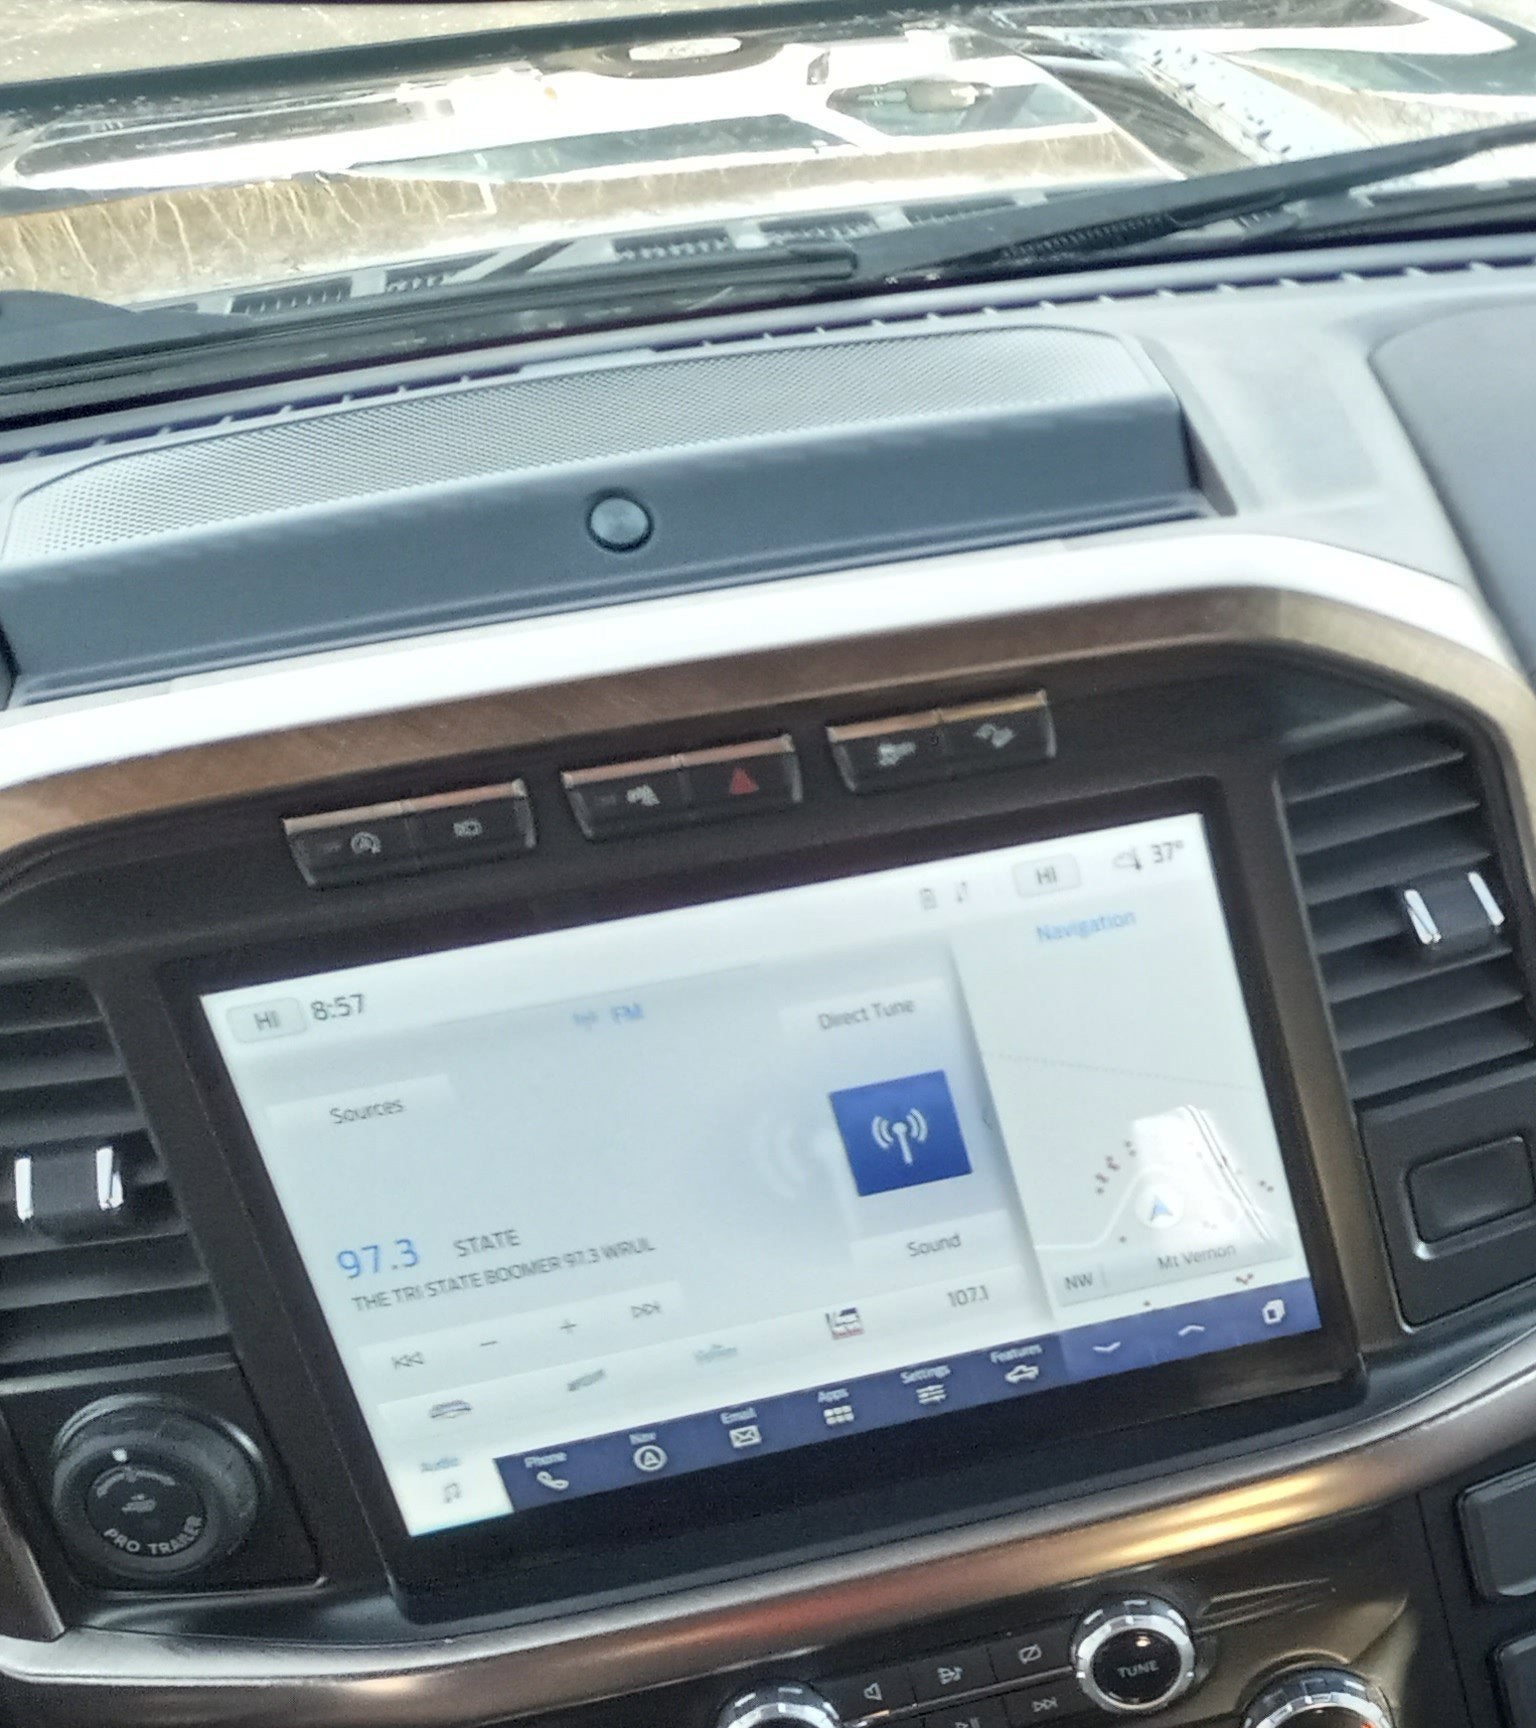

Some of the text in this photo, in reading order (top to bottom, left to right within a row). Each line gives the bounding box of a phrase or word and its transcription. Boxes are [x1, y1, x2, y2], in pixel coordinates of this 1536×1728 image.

[1036, 909, 1137, 943] Navigation
[310, 993, 367, 1022] 8:57
[818, 996, 916, 1032] Direct Tune
[329, 1096, 405, 1126] Sources
[335, 1228, 521, 1280] 97.3 STATE
[905, 1233, 963, 1259] Sound
[352, 1291, 391, 1312] THE
[427, 1272, 483, 1298] STATE
[1064, 1272, 1093, 1291] NW
[103, 1527, 141, 1553] PRO
[1116, 1659, 1160, 1680] TUNE
